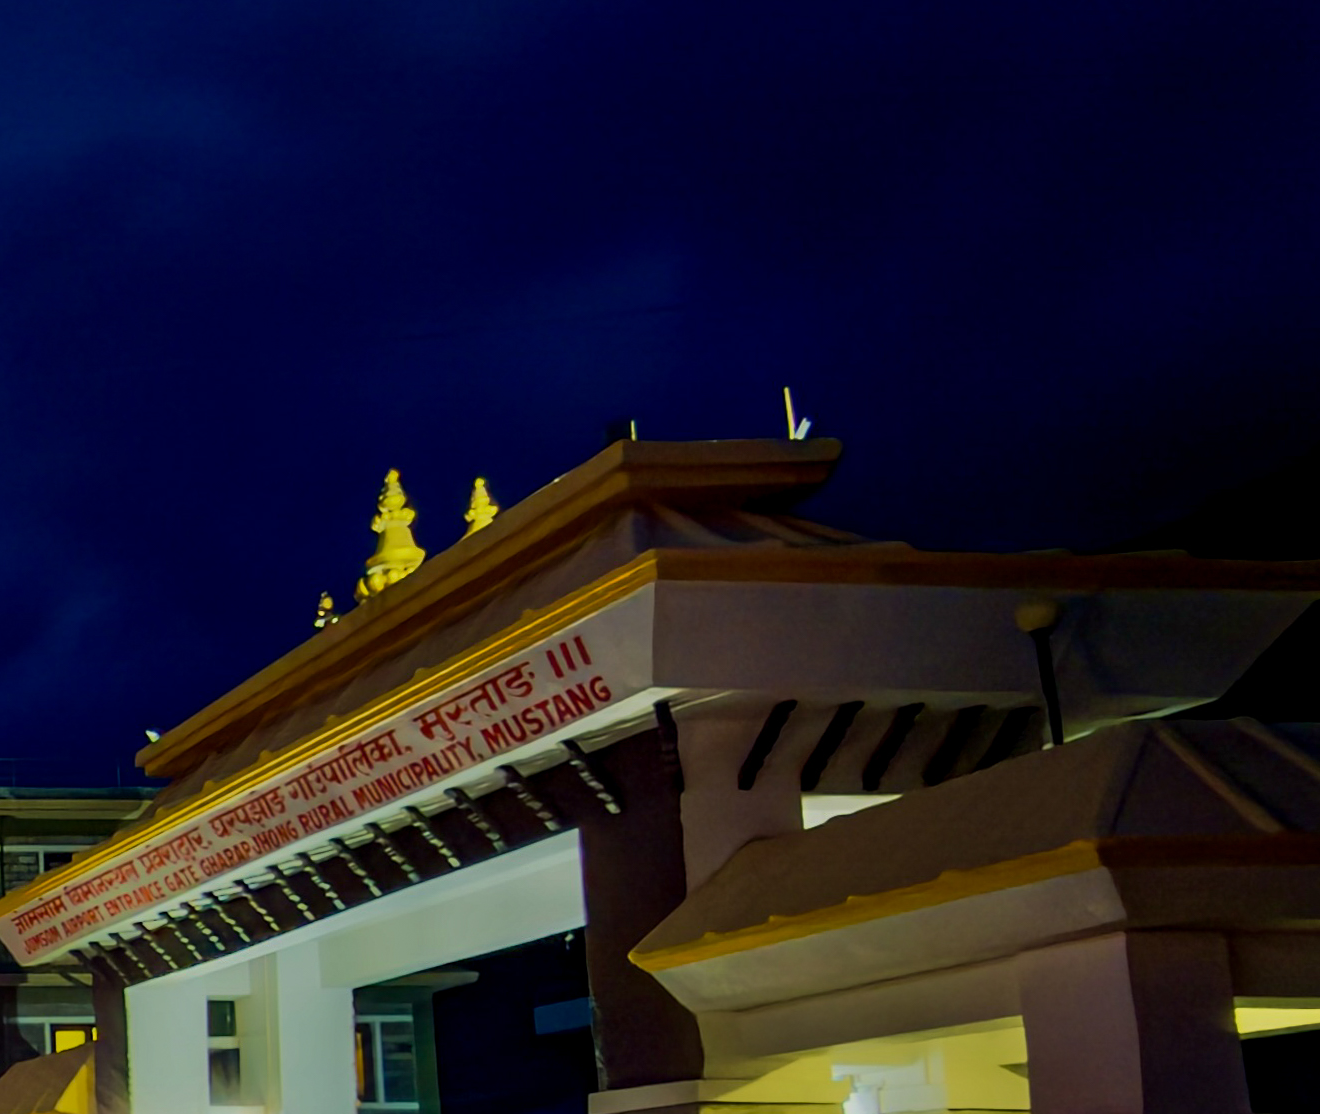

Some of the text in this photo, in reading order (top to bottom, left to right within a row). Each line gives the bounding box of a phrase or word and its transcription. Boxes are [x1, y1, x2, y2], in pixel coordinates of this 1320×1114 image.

[61, 906, 105, 938] AIRPORT
[103, 880, 166, 917] ENTRANCE
[164, 864, 200, 892] GATE
[297, 796, 355, 834] RURAL
[481, 675, 613, 753] MUSTANG
